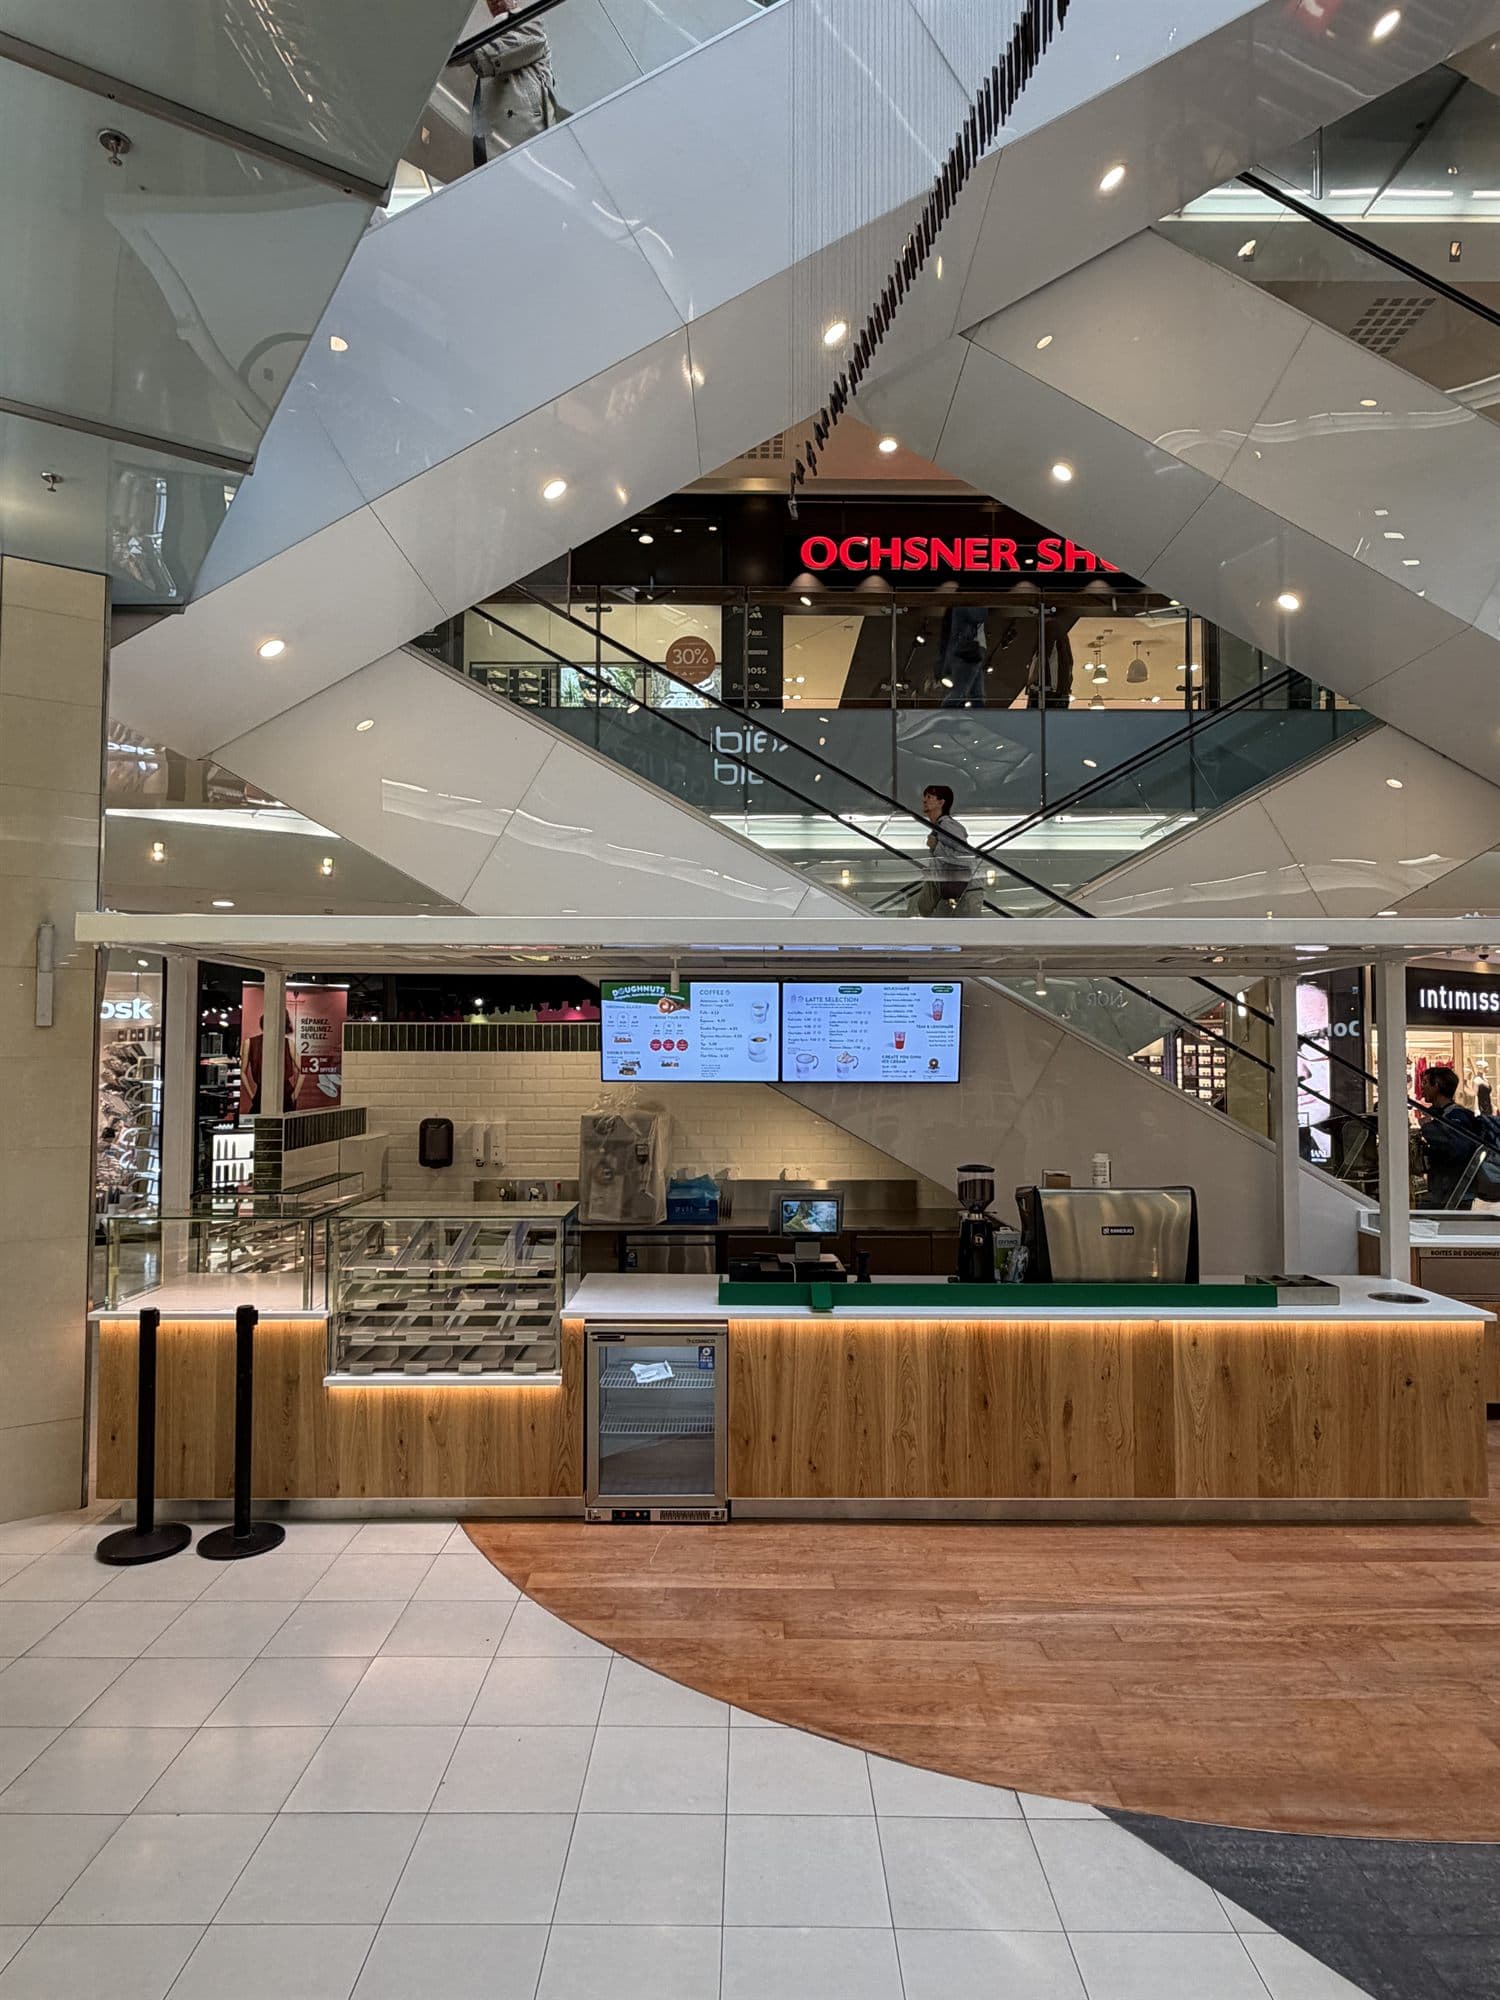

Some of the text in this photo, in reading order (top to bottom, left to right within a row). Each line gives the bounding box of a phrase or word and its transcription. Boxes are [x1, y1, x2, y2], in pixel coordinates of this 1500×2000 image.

[800, 536, 1120, 572] OCHSNER SH
[672, 648, 709, 665] 30%
[612, 985, 666, 996] DOUGHNUTS
[1419, 985, 1500, 1011] intimiss
[301, 1042, 310, 1054] 2
[309, 1057, 319, 1073] 3
